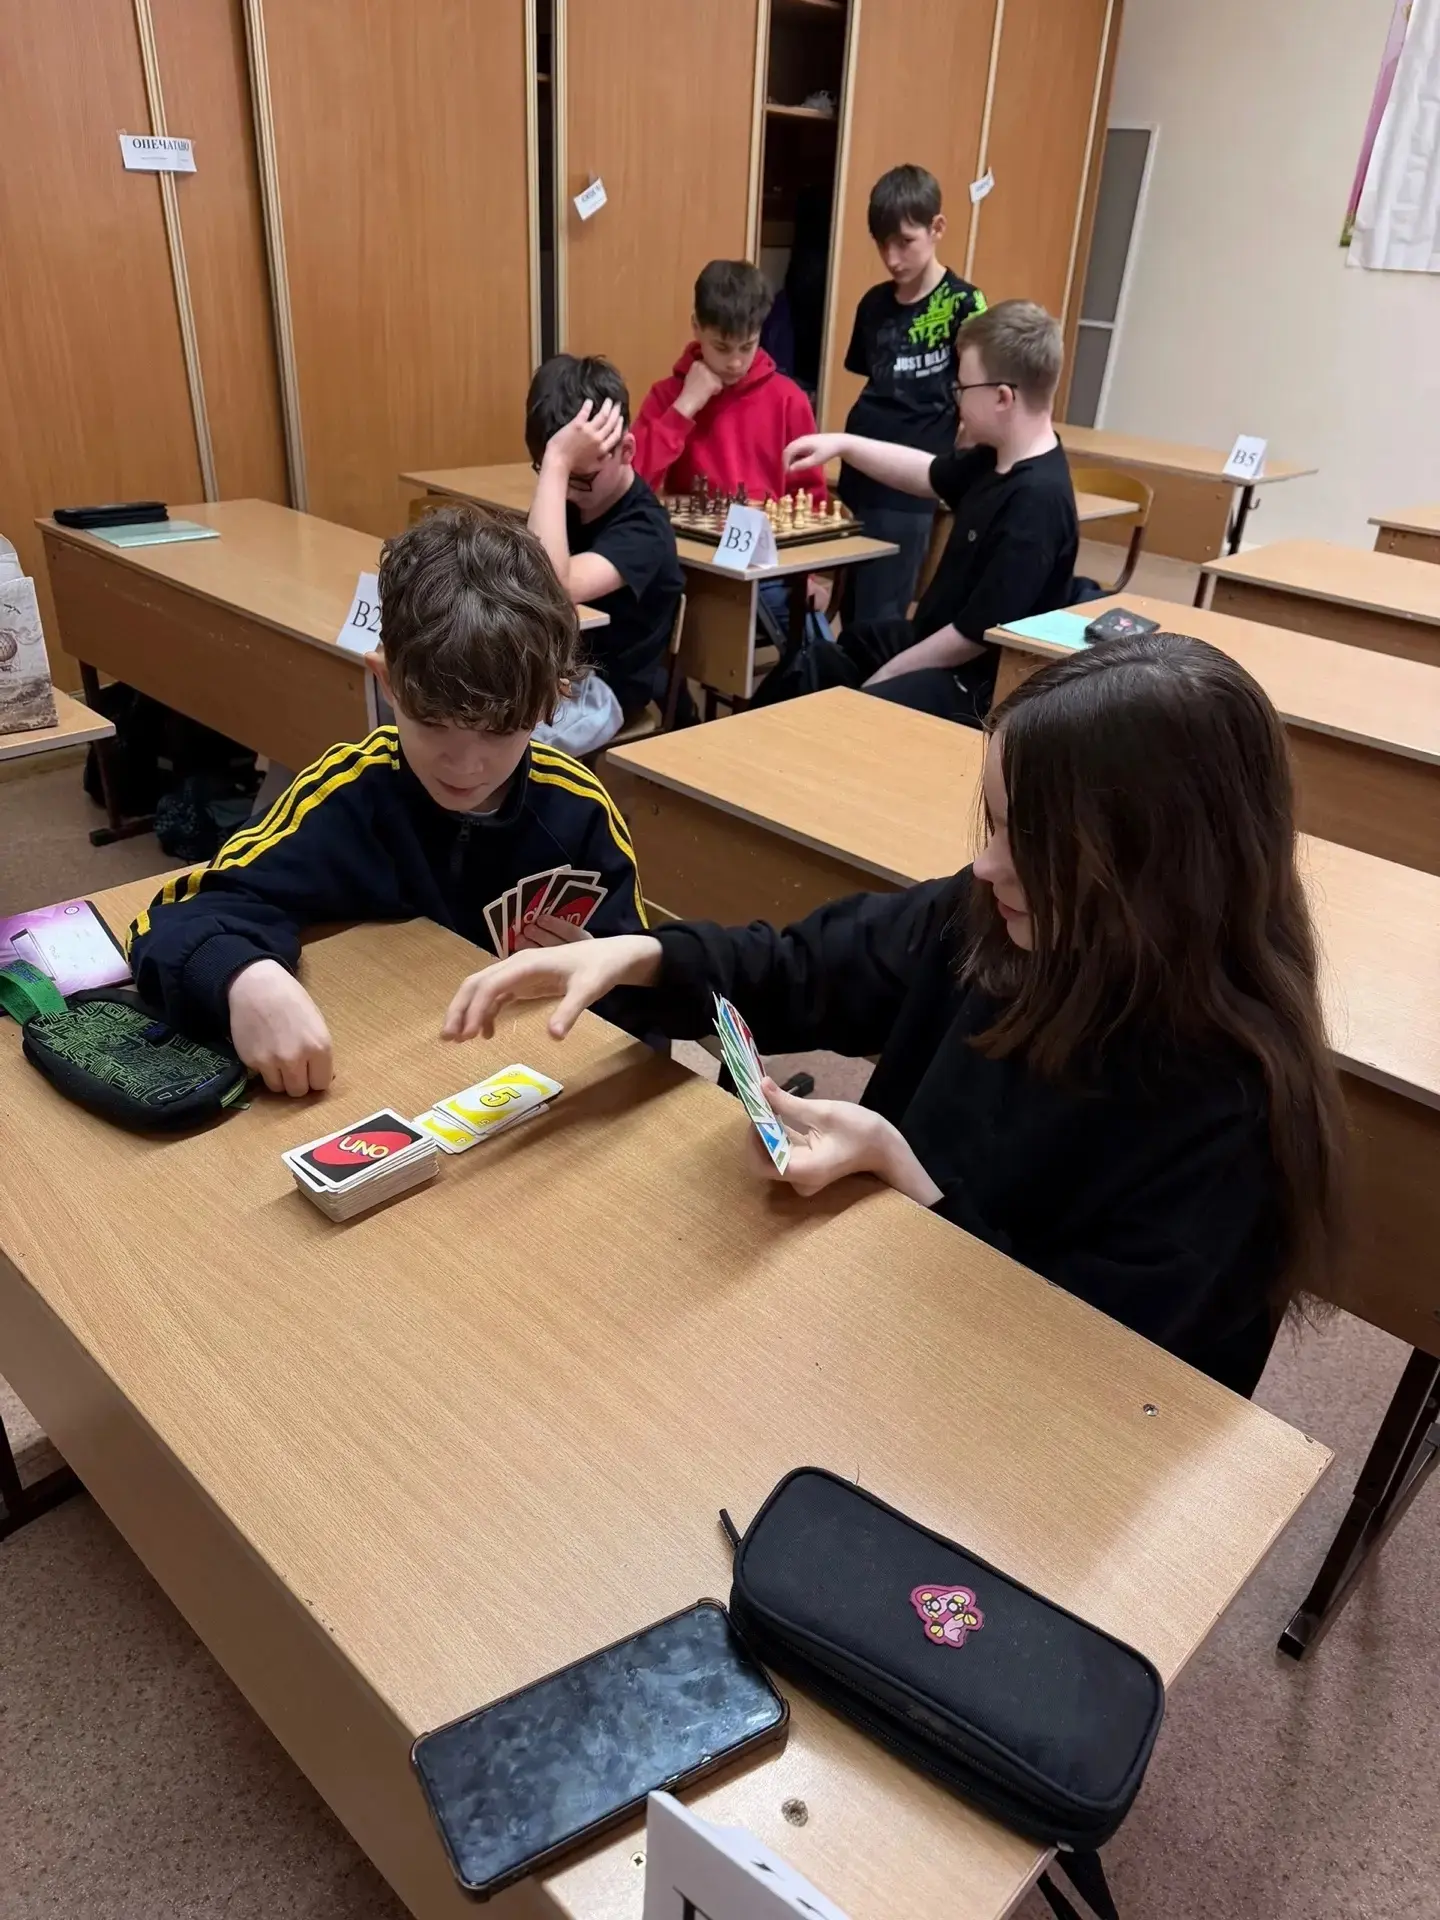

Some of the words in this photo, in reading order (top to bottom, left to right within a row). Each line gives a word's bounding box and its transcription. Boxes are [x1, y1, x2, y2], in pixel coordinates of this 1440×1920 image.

[893, 355, 922, 371] JUST
[1232, 449, 1258, 467] B5
[724, 526, 752, 552] B3
[350, 600, 382, 633] B2
[479, 1086, 522, 1108] 5
[339, 1136, 390, 1160] UNO
